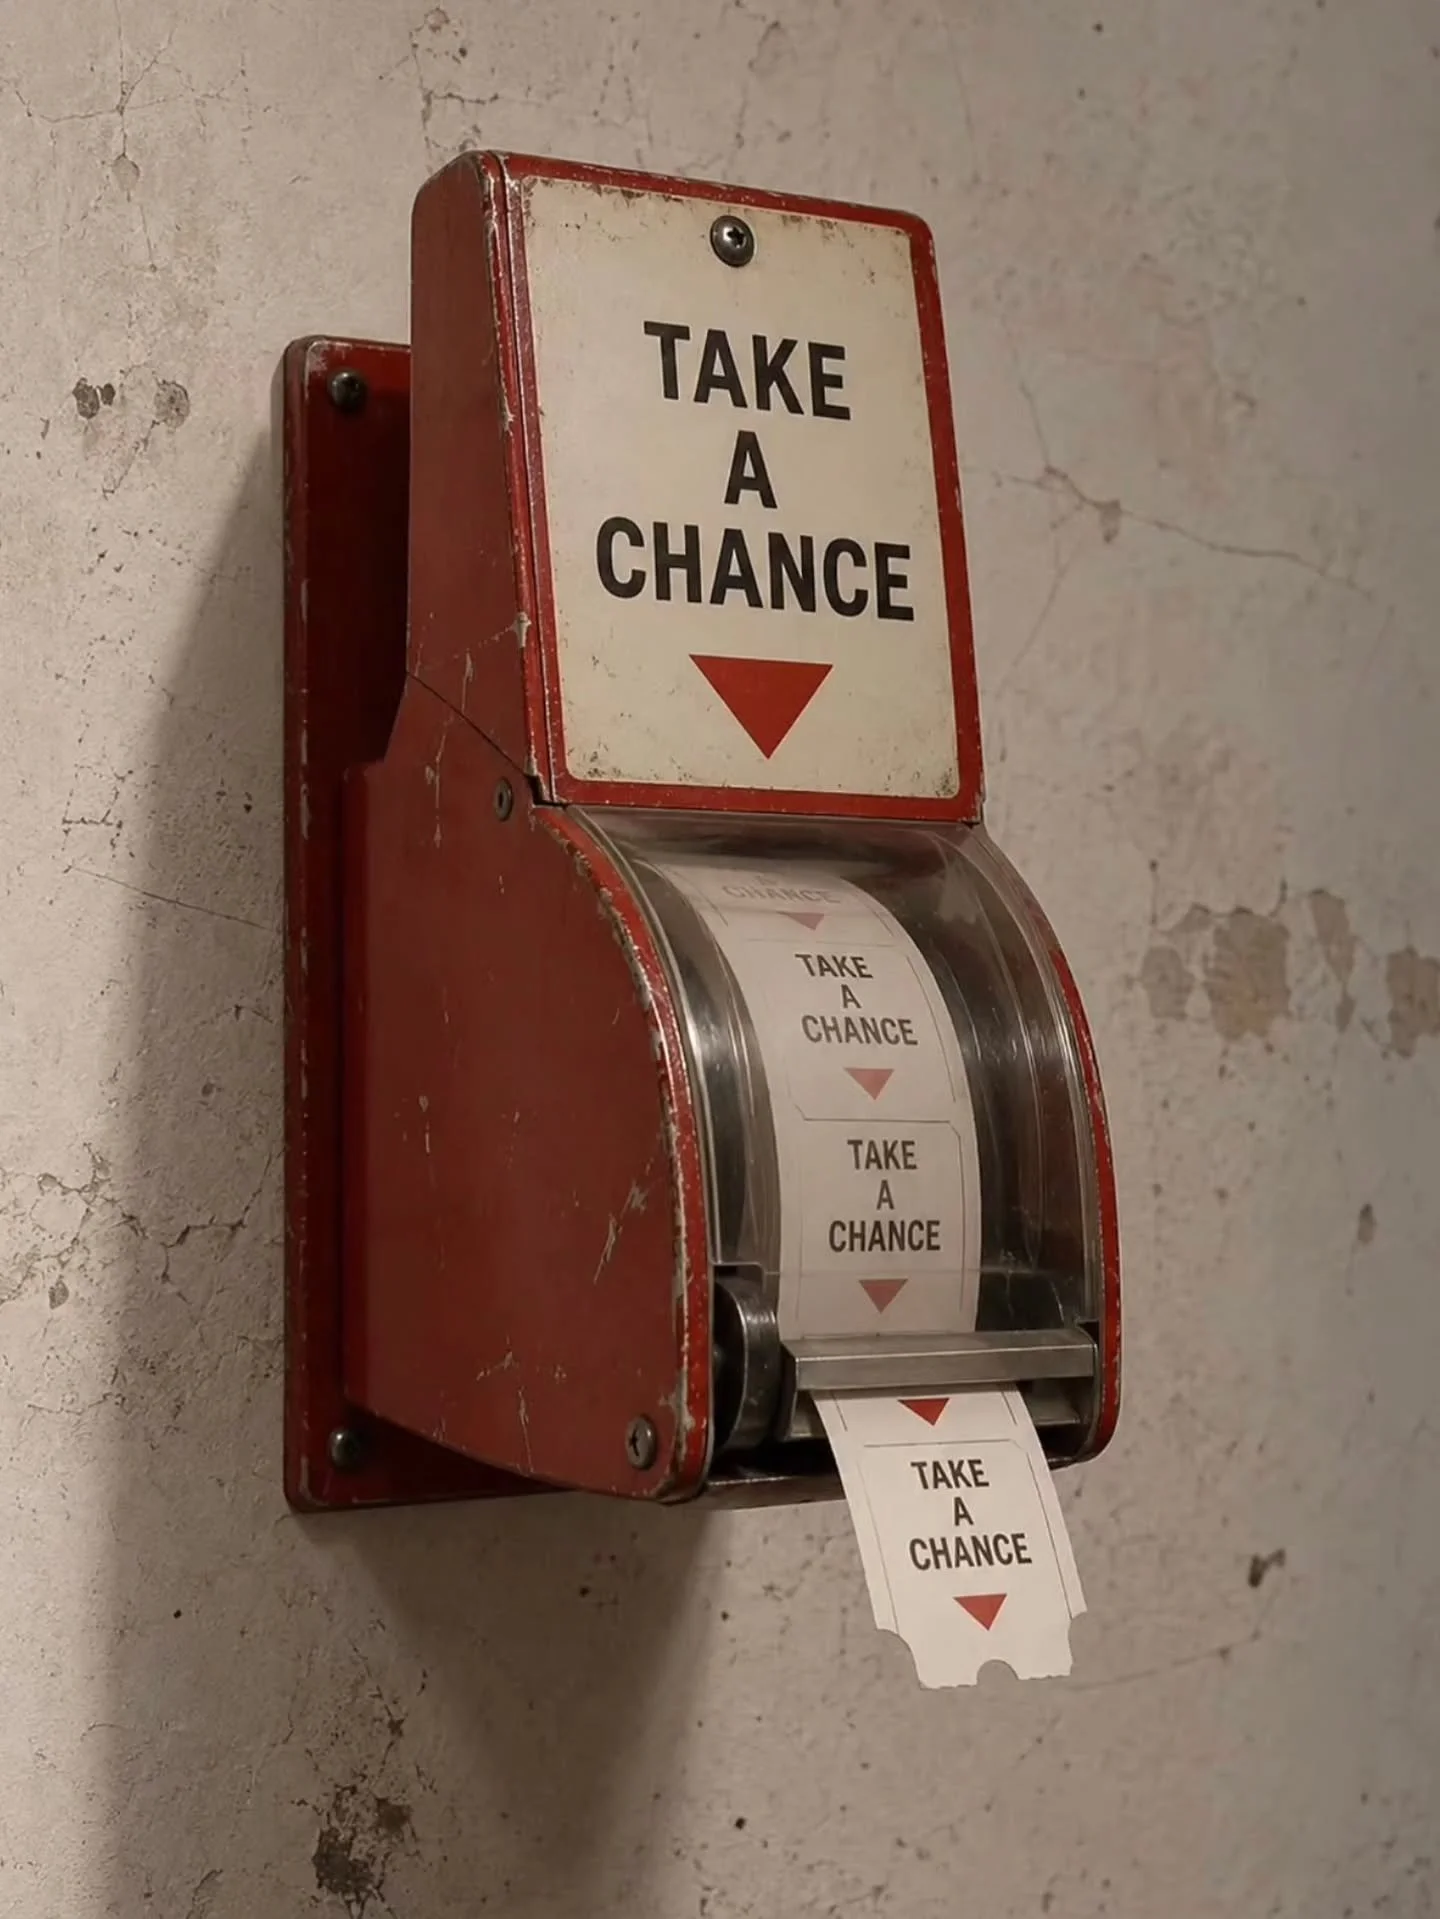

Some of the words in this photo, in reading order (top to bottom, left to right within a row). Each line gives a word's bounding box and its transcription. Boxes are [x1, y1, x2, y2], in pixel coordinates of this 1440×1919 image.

[643, 320, 851, 421] TAKE
[724, 430, 778, 509] A
[597, 516, 915, 621] CHANCE
[795, 953, 873, 979] TAKE
[840, 984, 861, 1009] A
[801, 1014, 918, 1046] CHANCE
[847, 1139, 918, 1171] TAKE
[876, 1180, 895, 1210] A
[828, 1219, 941, 1253] CHANCE
[910, 1458, 990, 1490] TAKE
[953, 1497, 974, 1527] A
[909, 1532, 1032, 1571] CHANCE
